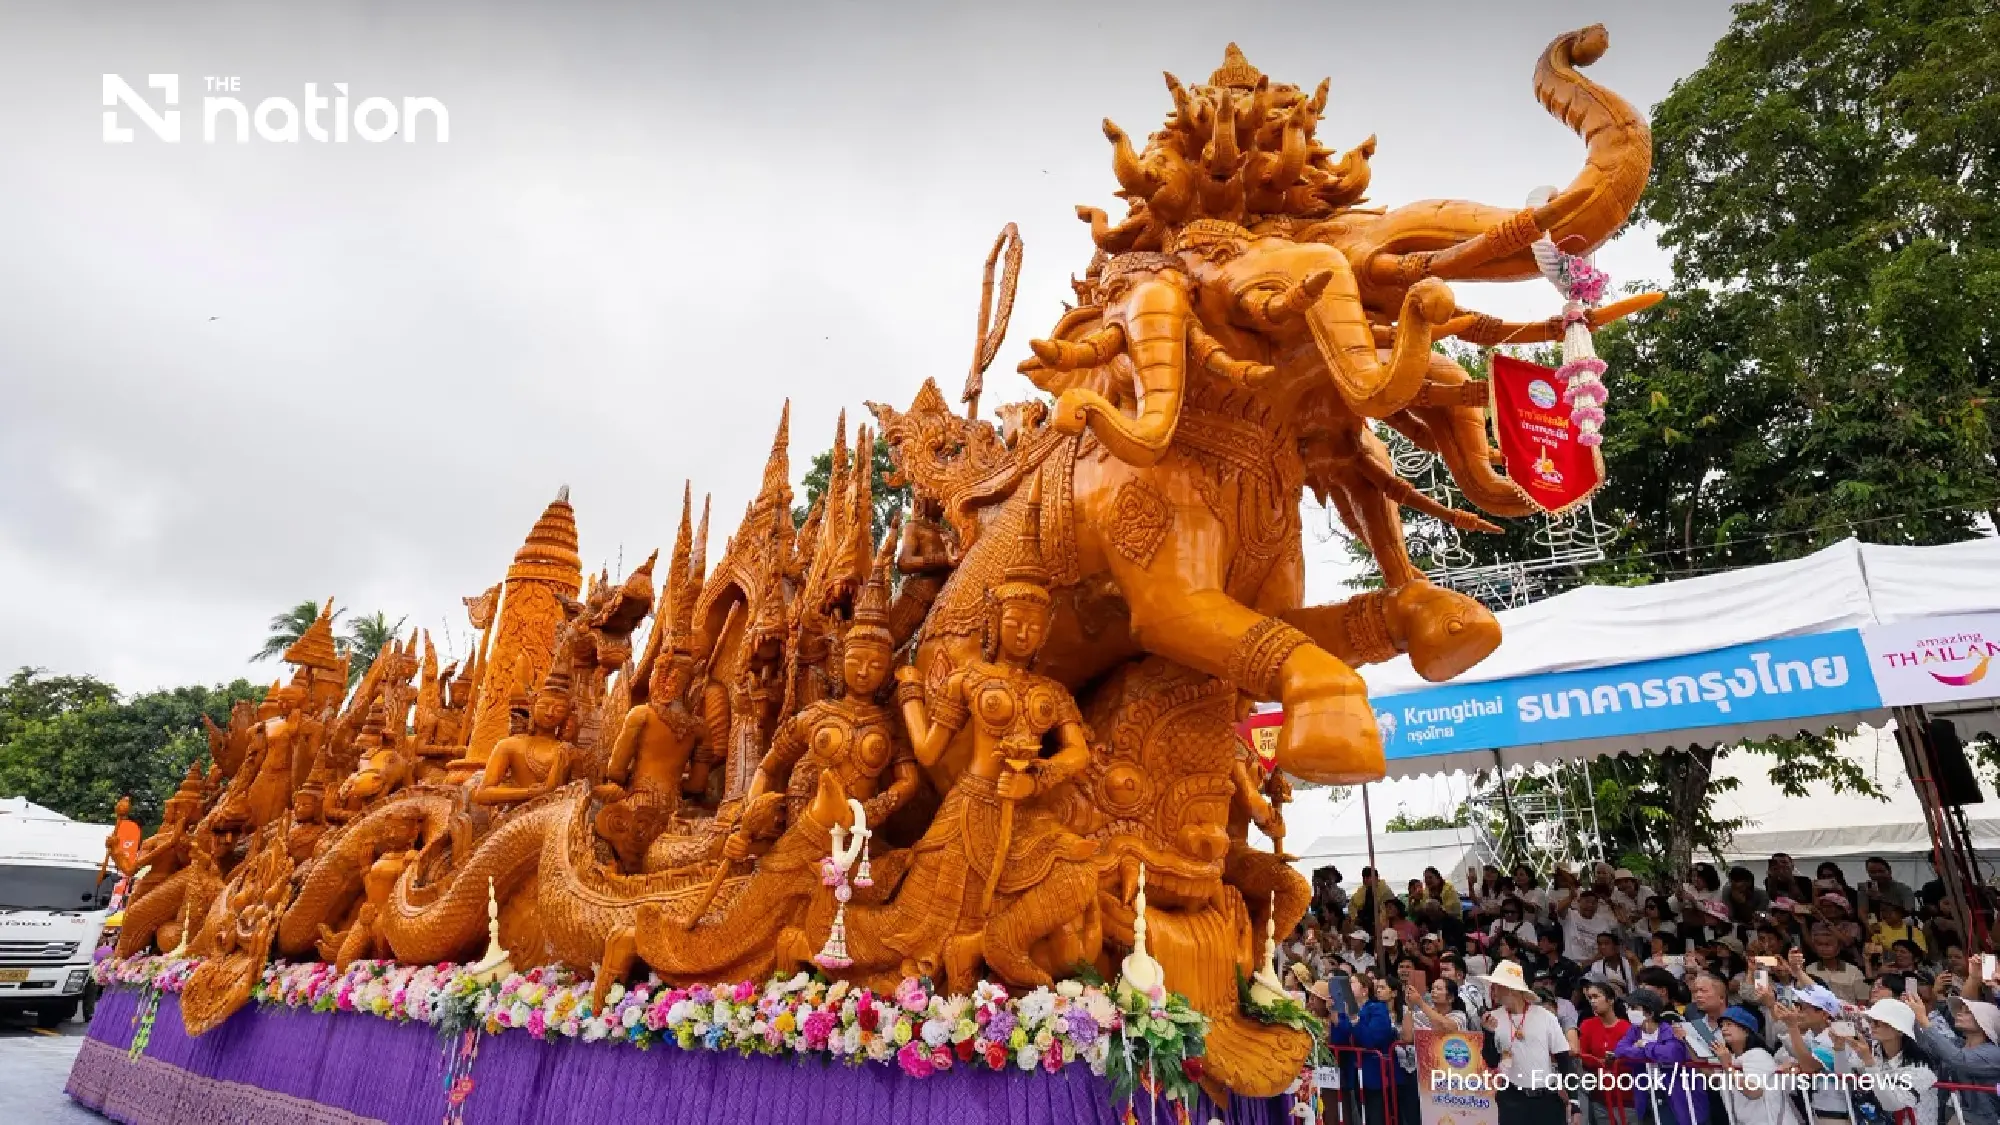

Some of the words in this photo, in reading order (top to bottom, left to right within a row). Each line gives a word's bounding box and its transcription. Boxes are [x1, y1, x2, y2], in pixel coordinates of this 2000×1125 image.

[1916, 633, 1984, 648] amazing
[1517, 652, 1849, 724] ธนาคารกรุงไทย
[1404, 696, 1503, 726] Krungthai
[1407, 725, 1455, 746] กรุงไทย
